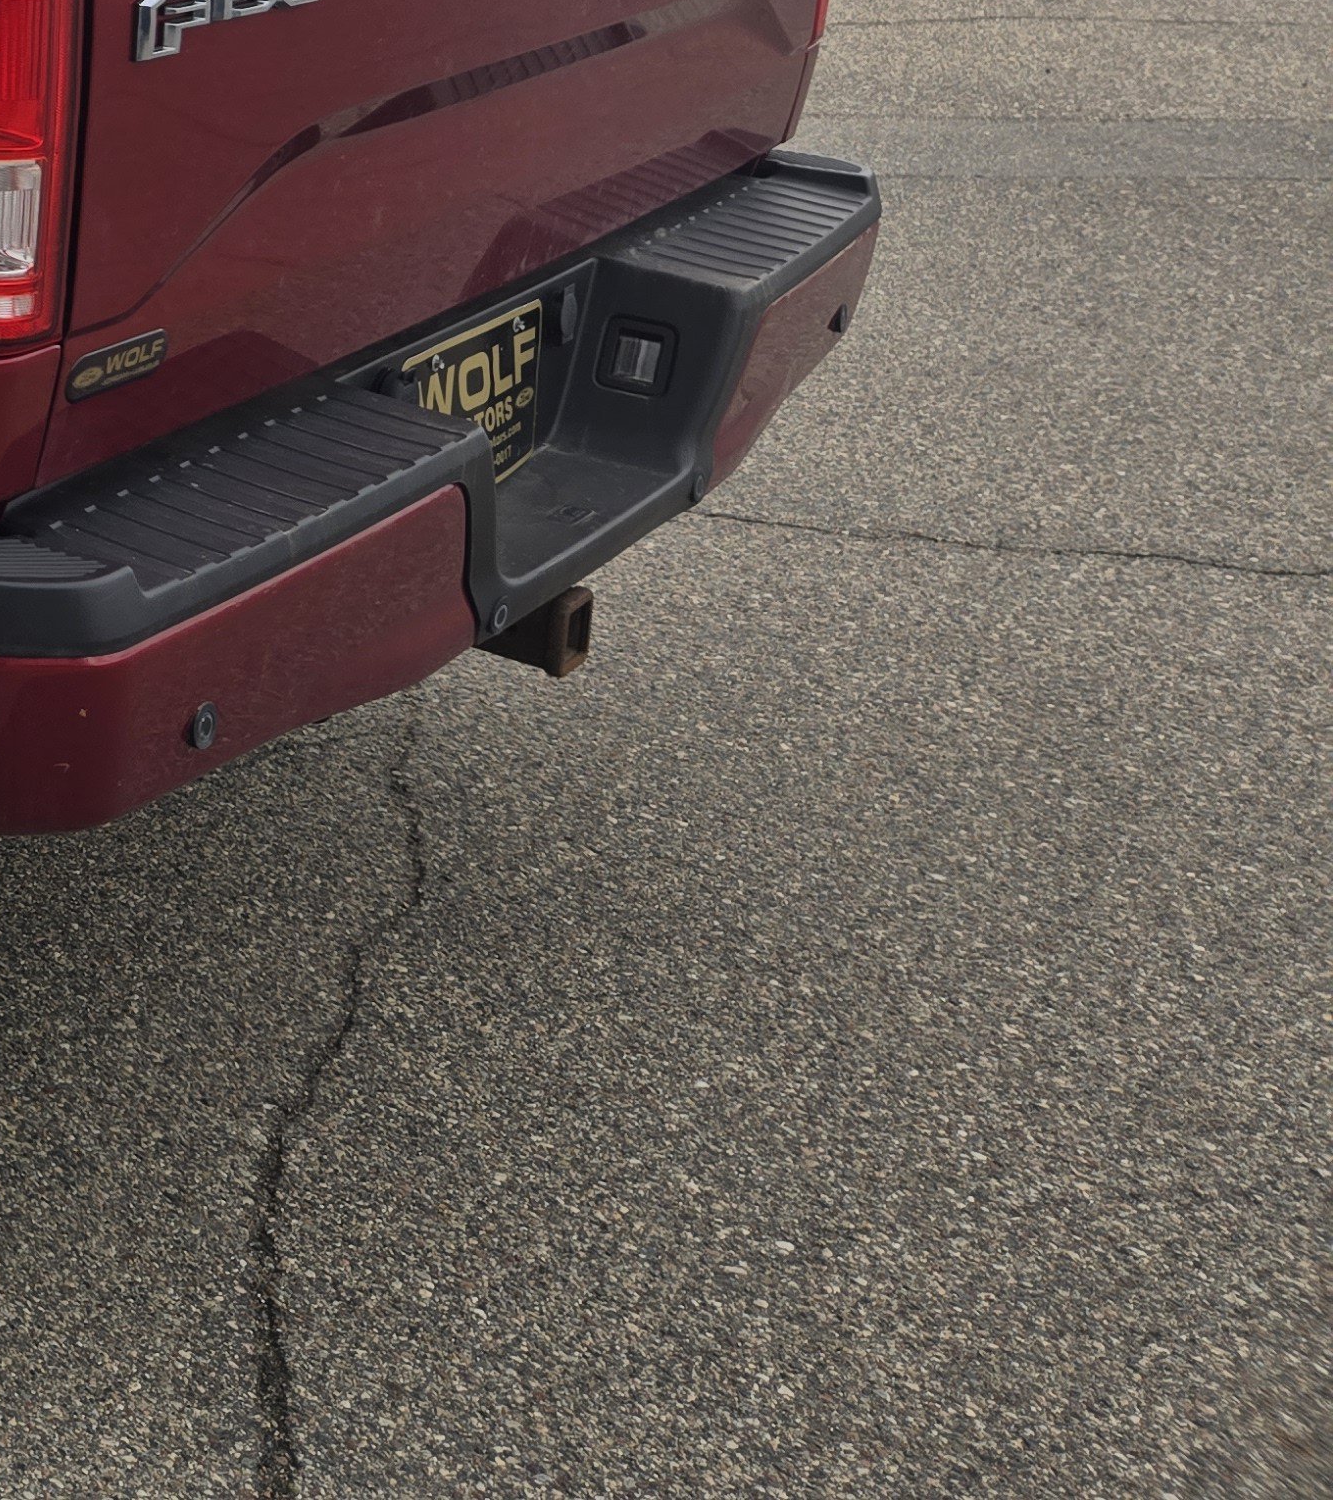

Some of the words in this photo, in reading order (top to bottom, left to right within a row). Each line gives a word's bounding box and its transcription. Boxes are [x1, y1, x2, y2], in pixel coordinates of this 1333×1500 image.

[106, 338, 165, 374] WOLF
[417, 327, 537, 416] WOLF
[466, 395, 514, 432] TORS
[490, 421, 522, 447] tors.com
